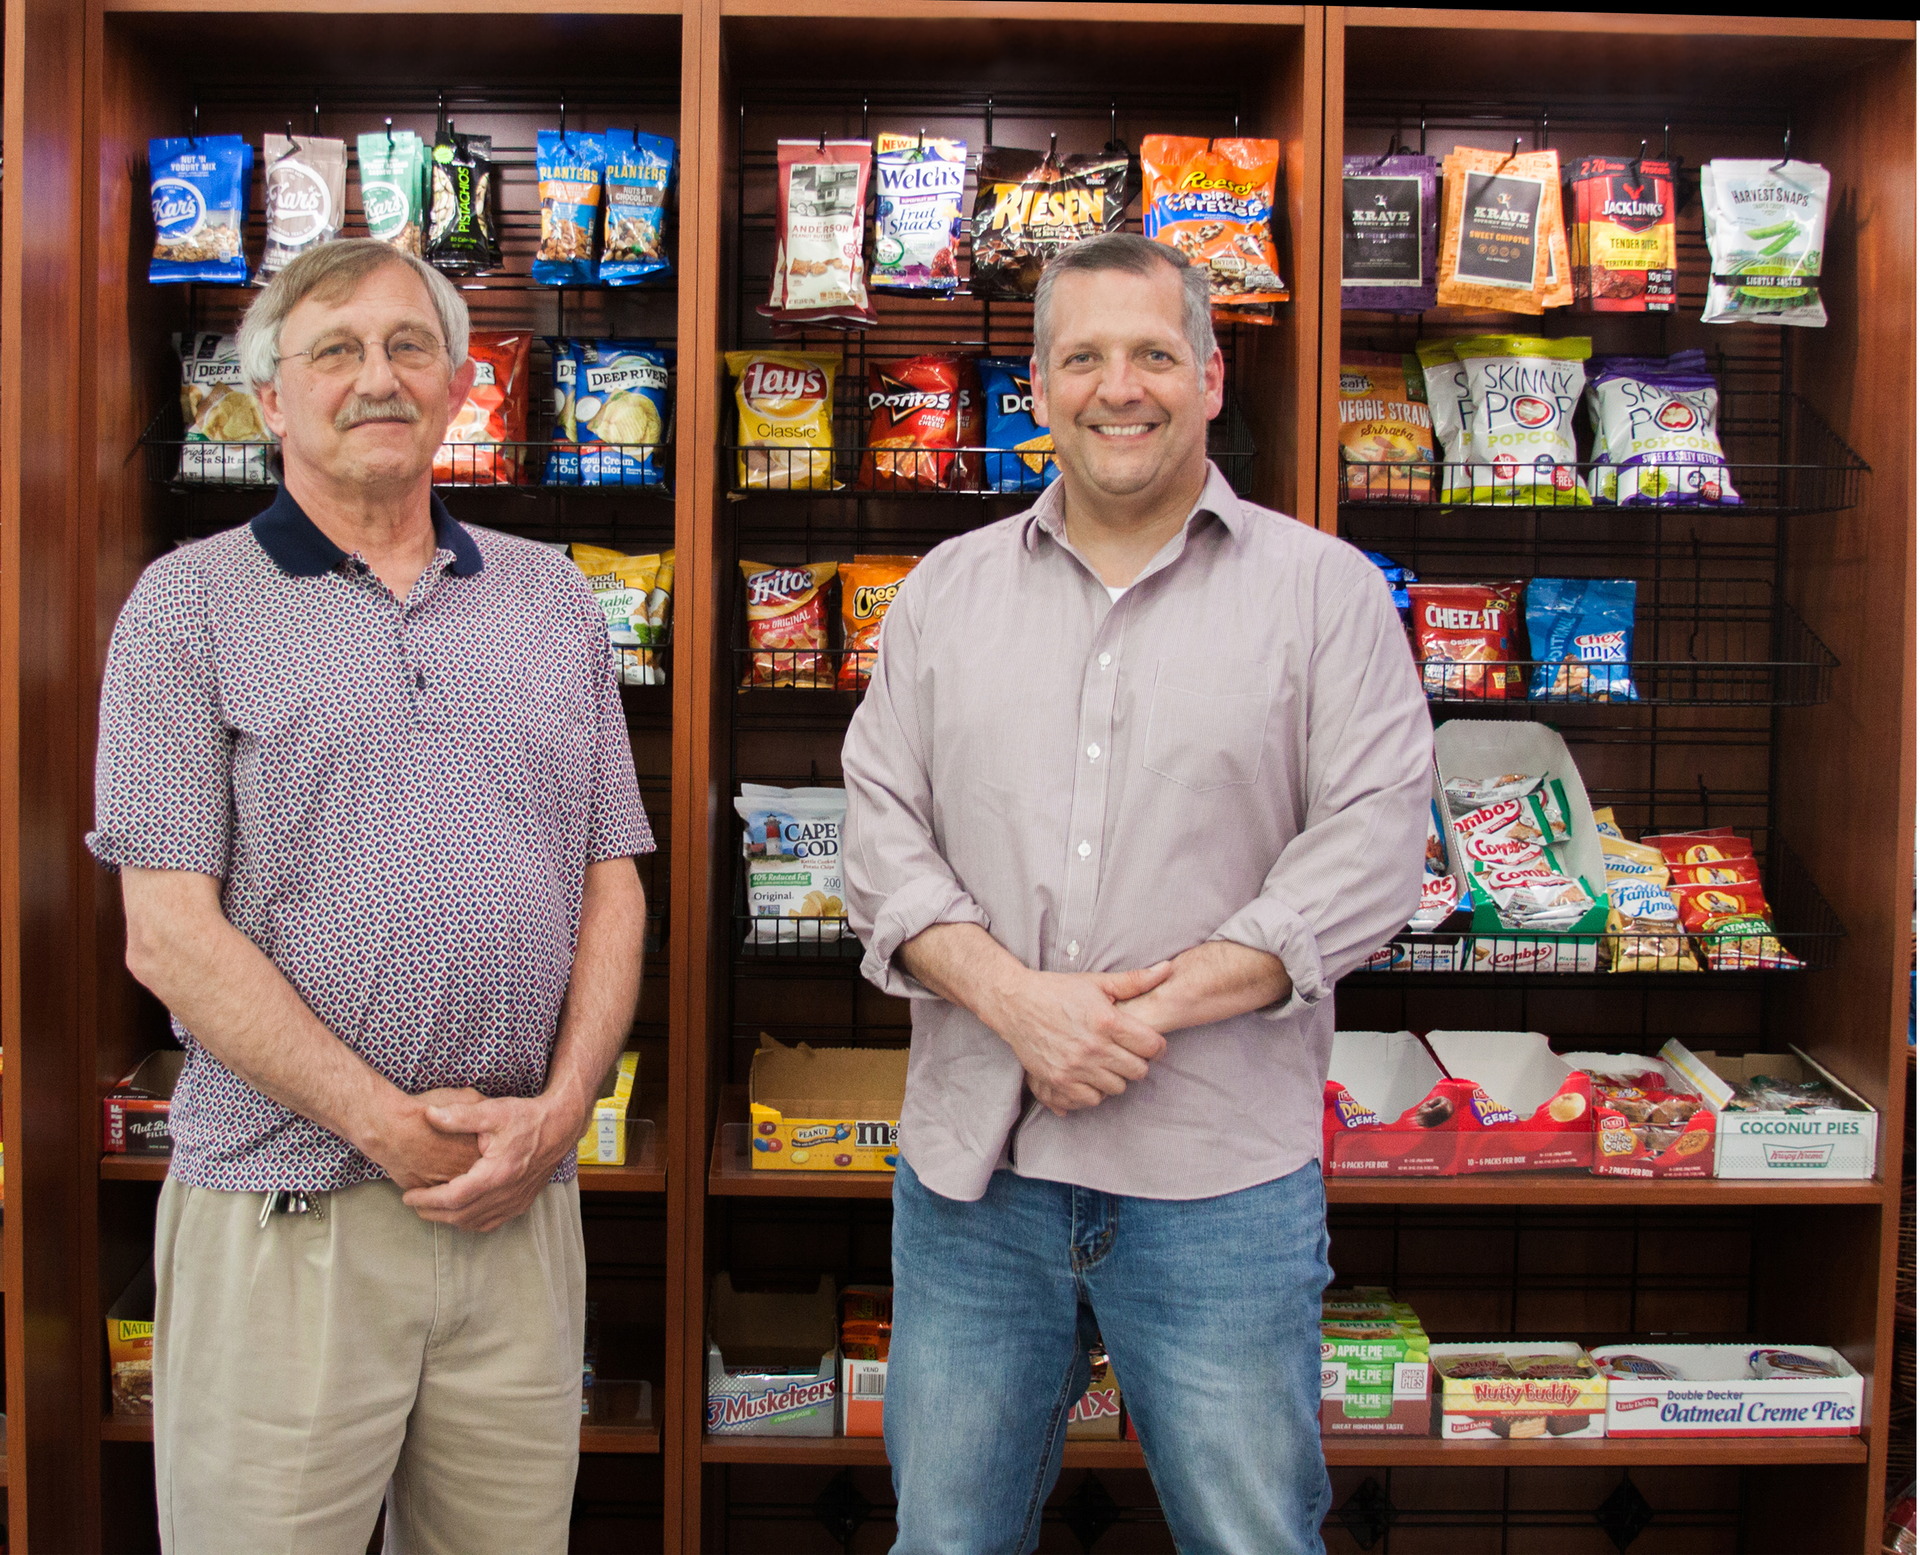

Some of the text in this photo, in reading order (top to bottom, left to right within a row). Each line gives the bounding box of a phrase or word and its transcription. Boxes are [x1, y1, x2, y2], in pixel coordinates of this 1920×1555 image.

[180, 155, 196, 164] NUT
[170, 163, 216, 172] YOGURT MIX
[539, 166, 598, 183] PLANTERS
[606, 165, 667, 182] PLANTERS
[880, 167, 961, 190] Welch's
[1180, 170, 1255, 196] Reese's
[624, 186, 640, 194] NUTS
[458, 166, 470, 232] PISTACHIOS
[616, 194, 654, 202] CHOCOLATE
[1731, 188, 1810, 207] HARVEST SNAPS
[900, 207, 936, 221] Fruit
[992, 184, 1105, 234] RIESEN
[1474, 206, 1531, 224] KRAVE
[1602, 200, 1664, 217] JACK LINK'S
[1352, 210, 1410, 222] KRAVE
[792, 224, 850, 234] ANDERSON
[890, 218, 943, 235] Snacks
[1470, 230, 1530, 245] SWEET CHIPOTLE
[1610, 238, 1659, 250] TENDER BITES
[1605, 260, 1634, 268] TERIYAKI
[1648, 272, 1662, 282] 10g
[1746, 276, 1774, 286] LIGHTLY
[1647, 285, 1658, 294] 70
[199, 365, 232, 377] DEEP
[591, 369, 668, 386] DEEP RIVER
[1484, 361, 1574, 394] SKINNY
[750, 364, 821, 400] Lay's
[868, 392, 951, 412] Doritos
[1338, 399, 1386, 424] VEGGIE
[1486, 391, 1573, 434] POP
[918, 420, 945, 430] CHEESE
[921, 414, 946, 424] NACHO
[1629, 399, 1712, 440] POP
[757, 423, 817, 438] Classic
[1361, 424, 1415, 441] Sriracha
[1488, 431, 1570, 448] POPCORN
[1632, 435, 1722, 453] POPCORN
[1697, 453, 1719, 464] KETTLE
[748, 568, 812, 606] Fritos
[758, 610, 811, 630] The ORIGINAL
[1450, 638, 1486, 646] ORIGINAL
[1583, 644, 1622, 661] mix
[784, 824, 838, 842] CAPE
[793, 840, 838, 858] COD
[1474, 839, 1531, 856] Combo
[768, 873, 796, 881] Reduced
[824, 878, 841, 889] 200
[754, 892, 792, 902] Original
[1632, 900, 1678, 918] Amos
[1496, 946, 1546, 963] Combos
[110, 1104, 122, 1138] CLIF
[1346, 1114, 1380, 1128] GEMS
[1482, 1112, 1517, 1126] GEMS
[130, 1122, 152, 1134] Nut
[798, 1128, 830, 1139] PEANUT
[1740, 1122, 1860, 1135] COCONUT PIES
[1602, 1130, 1632, 1142] Coffee
[1603, 1141, 1632, 1152] Cakes
[1468, 1158, 1474, 1166] 10
[1484, 1157, 1502, 1165] PACKS
[1502, 1156, 1514, 1164] PER
[1514, 1156, 1526, 1164] BOX
[1770, 1150, 1824, 1162] Krispy Kreme
[1330, 1161, 1336, 1169] 10
[1346, 1160, 1364, 1168] PACKS
[1365, 1160, 1376, 1168] PER
[1376, 1160, 1388, 1168] BOX
[1608, 1166, 1613, 1174] 2
[1613, 1166, 1630, 1176] PACKS
[1630, 1168, 1641, 1176] PER
[1642, 1169, 1654, 1177] BOX
[1337, 1344, 1366, 1358] APPLE
[1368, 1345, 1383, 1357] PIE
[1366, 1369, 1382, 1381] PIE
[1401, 1370, 1424, 1378] SNACK
[1401, 1377, 1424, 1389] PIES
[1366, 1394, 1381, 1406] PIE
[1474, 1382, 1580, 1407] Nutty Buddy
[1667, 1390, 1744, 1400] Double Decker
[1616, 1398, 1656, 1410] Little Debbie
[707, 1400, 724, 1426] 3
[1660, 1401, 1855, 1422] Oatmeal Creme Pies
[1453, 1421, 1492, 1432] Little Debbie
